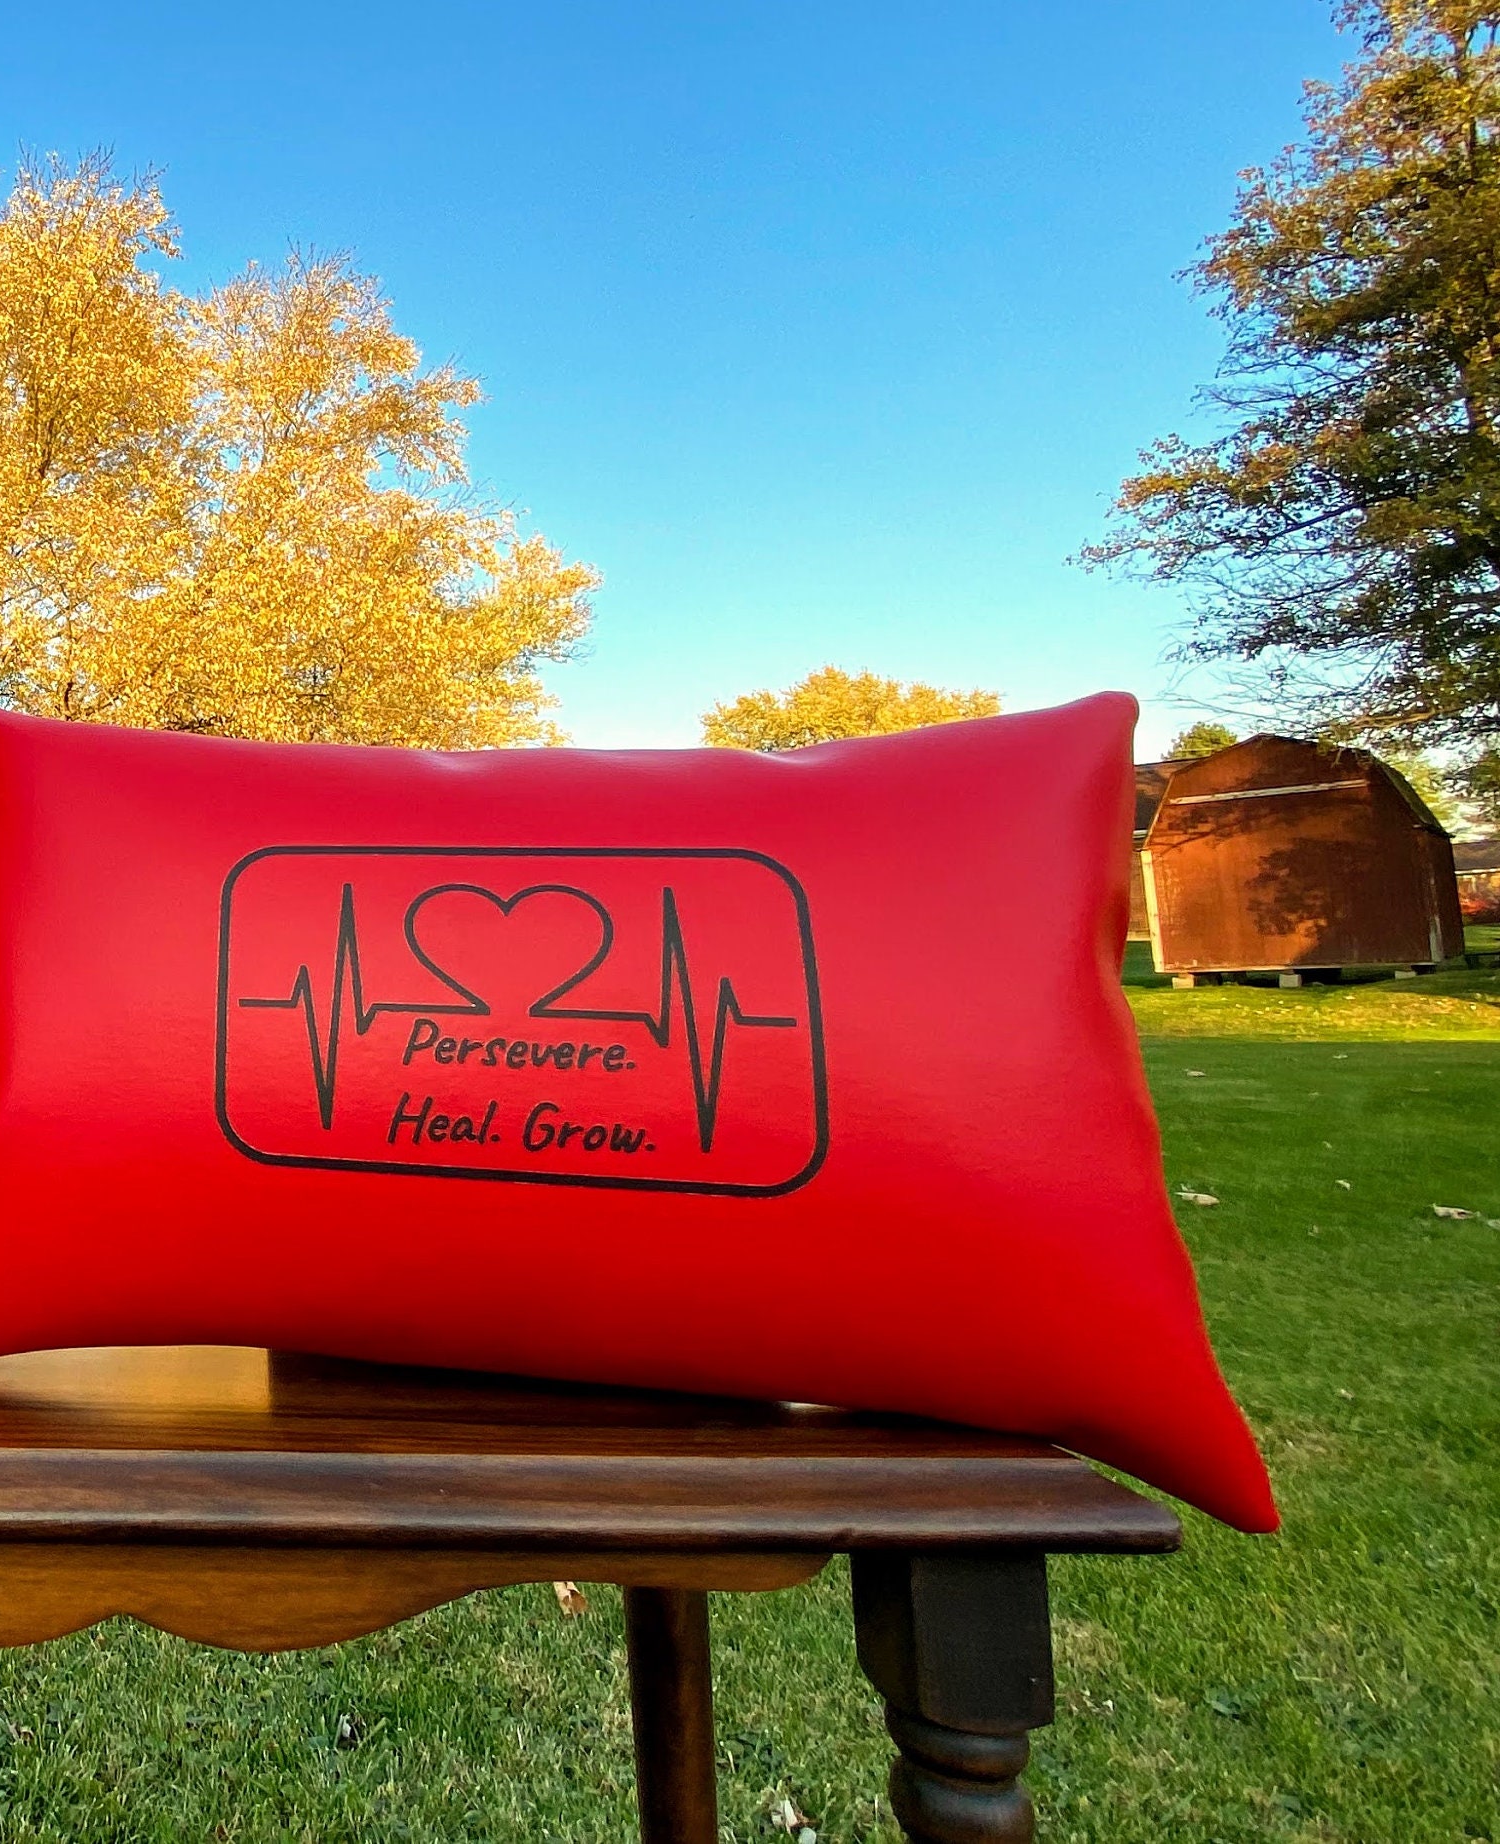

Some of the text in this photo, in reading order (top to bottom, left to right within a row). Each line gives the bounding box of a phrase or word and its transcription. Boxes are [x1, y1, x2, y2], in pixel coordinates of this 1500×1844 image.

[402, 1018, 636, 1071] Persevere.
[387, 1093, 656, 1154] Heal. Grow.
